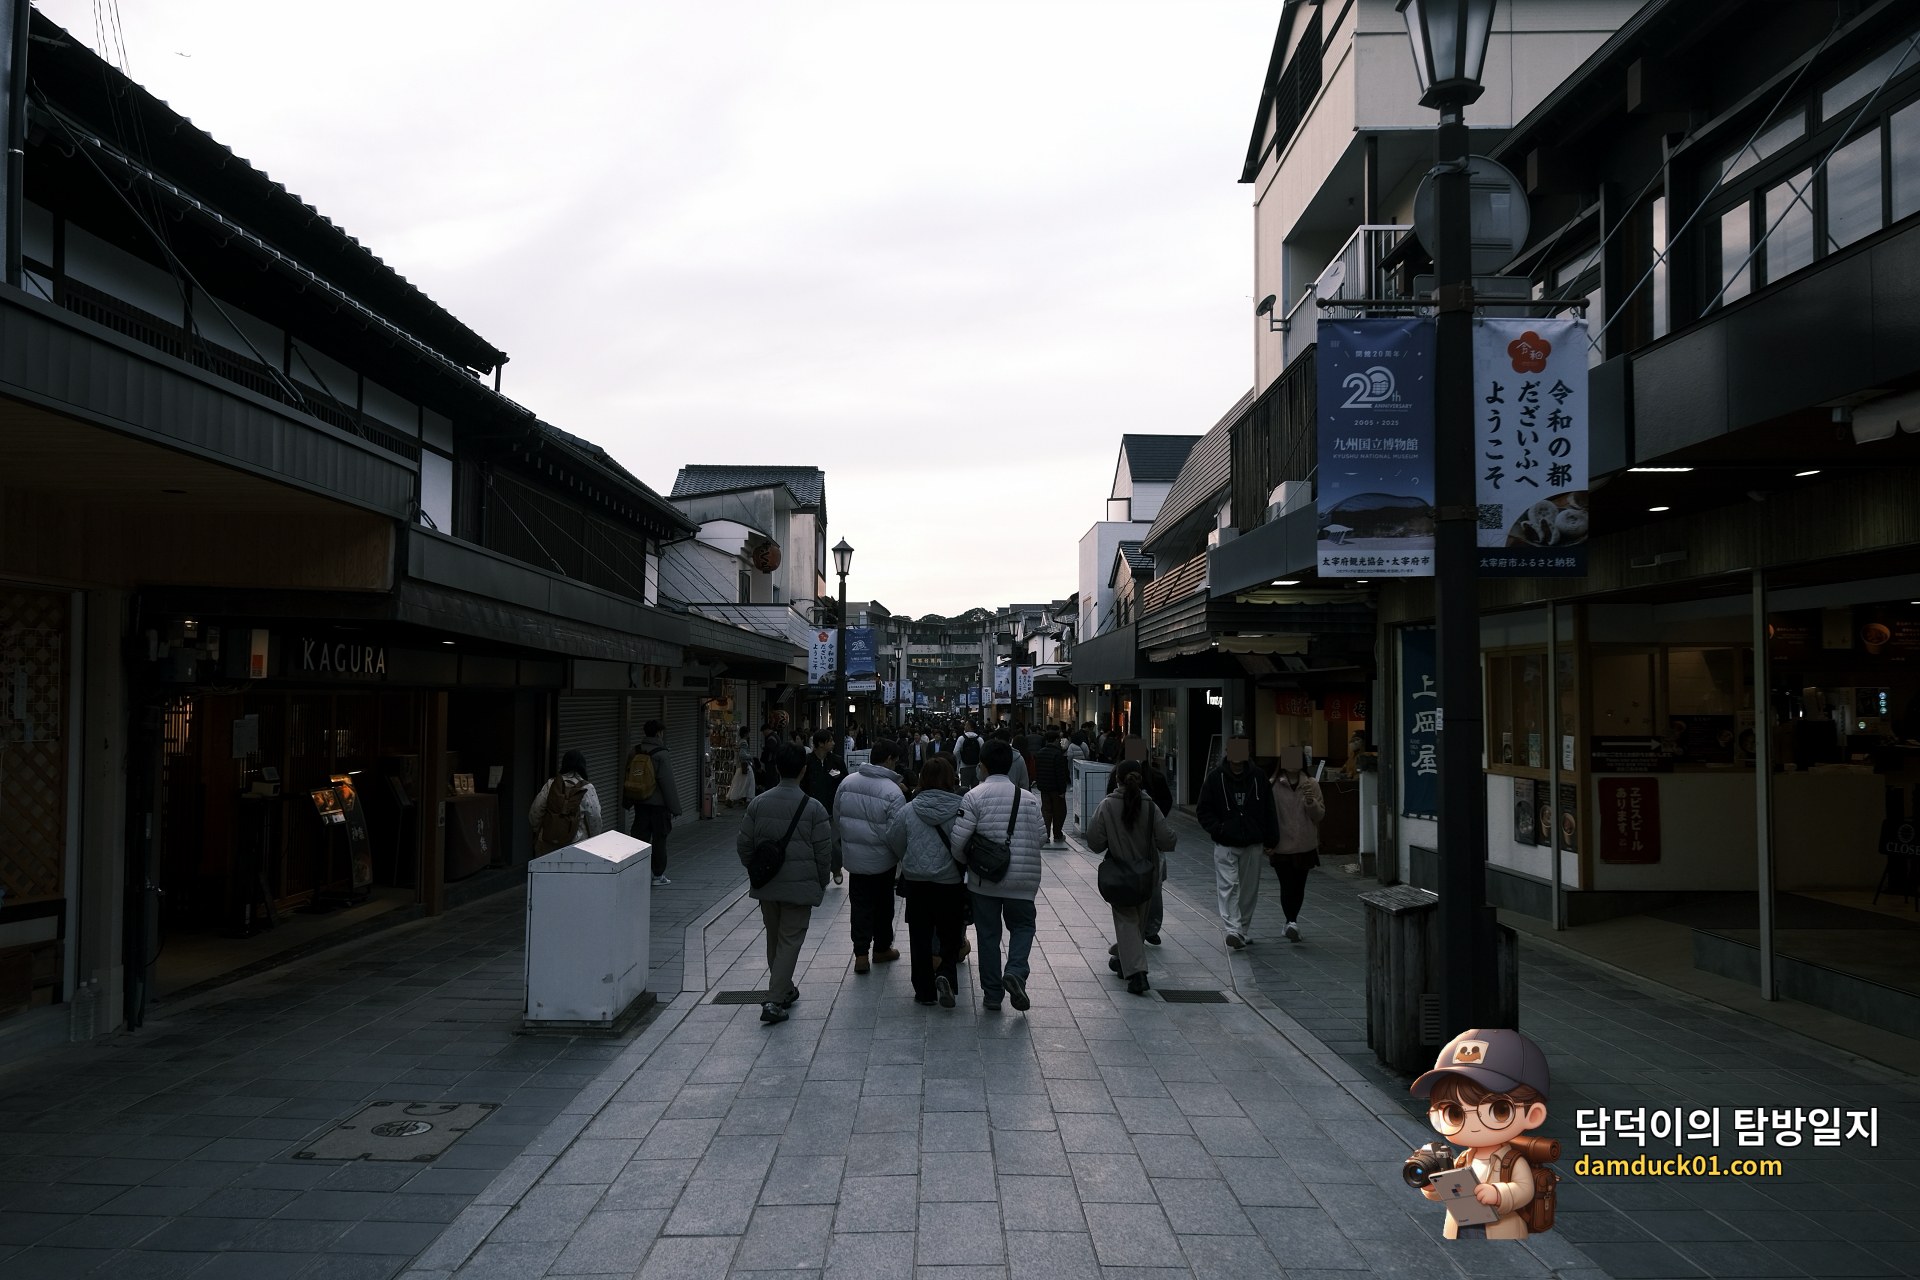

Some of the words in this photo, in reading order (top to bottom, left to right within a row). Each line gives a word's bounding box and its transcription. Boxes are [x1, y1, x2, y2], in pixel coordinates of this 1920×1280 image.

[1333, 438, 1418, 451] 九州国立博物館
[1484, 381, 1505, 489] ようこそ
[1515, 380, 1541, 487] だざいふへ
[1546, 379, 1574, 487] 令和の都
[1479, 557, 1577, 569] 太宰府市ふるさと納税
[303, 640, 385, 674] KAGURA
